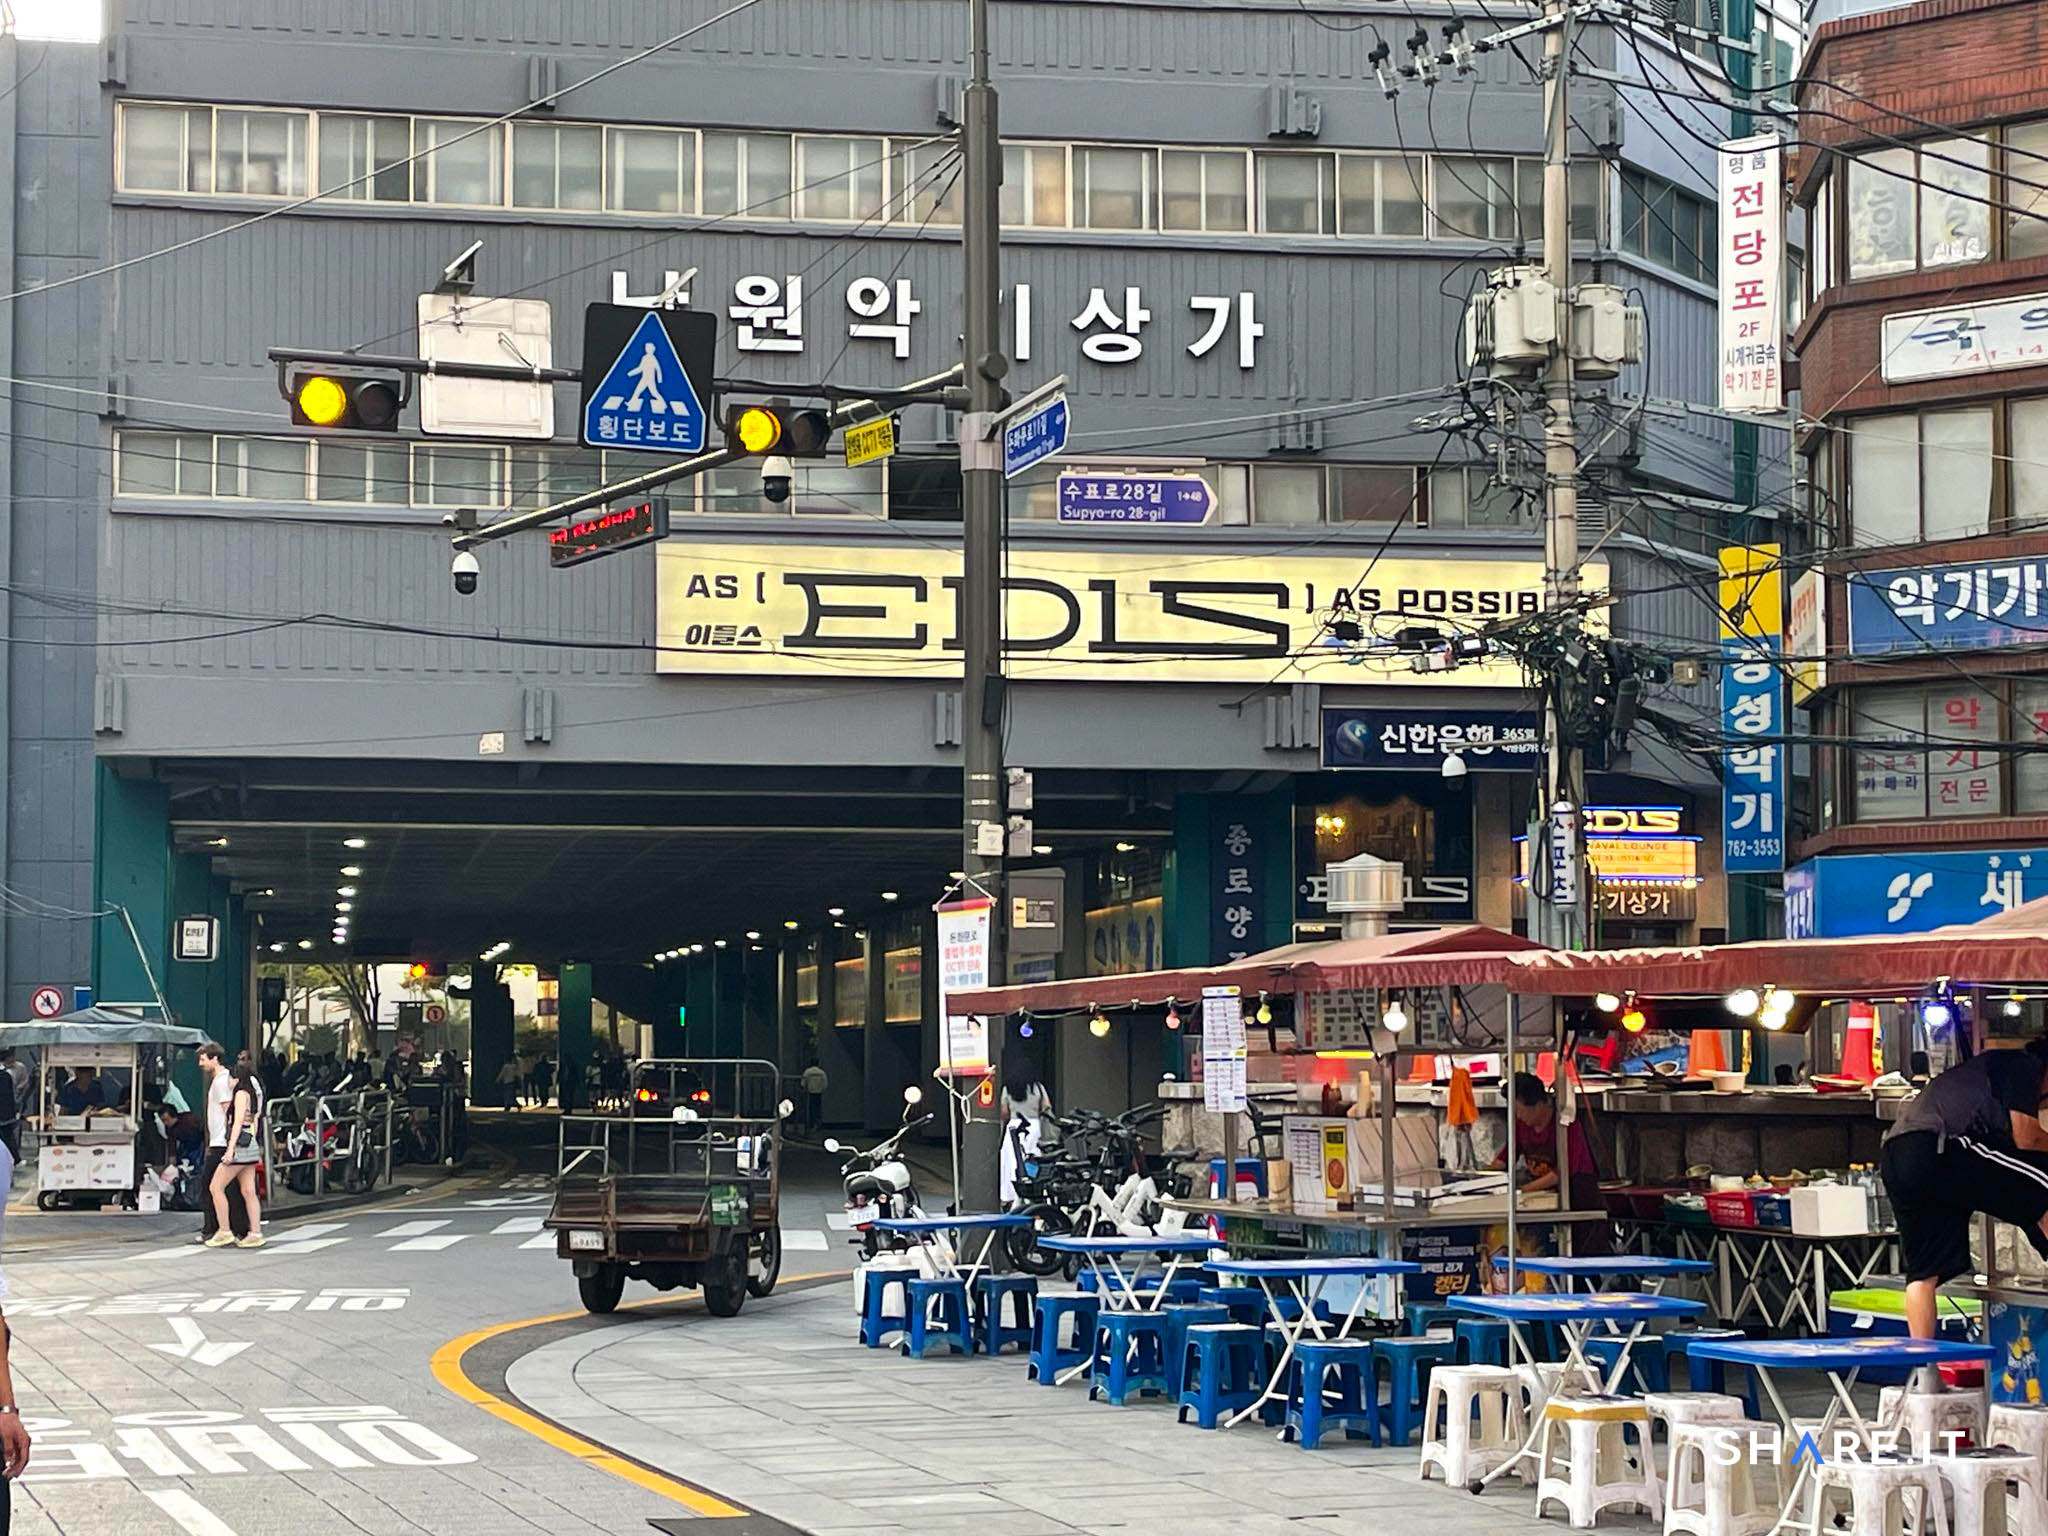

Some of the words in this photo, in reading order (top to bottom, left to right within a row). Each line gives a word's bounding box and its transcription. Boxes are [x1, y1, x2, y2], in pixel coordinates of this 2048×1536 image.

[1732, 182, 1767, 311] 전당포
[1739, 322, 1760, 338] 2F
[1725, 369, 1776, 394] 악기전문
[597, 415, 692, 443] 횡단보도
[1064, 482, 1161, 504] 수표로28길
[1064, 505, 1125, 520] Supyo-ro
[1128, 506, 1166, 521] 28-gil
[686, 574, 738, 599] AS
[1333, 588, 1381, 612] AS
[1397, 588, 1547, 614] POSSIB
[1379, 724, 1495, 754] 신한은행
[1939, 778, 1990, 804] 전문
[1726, 840, 1780, 857] 762-3553
